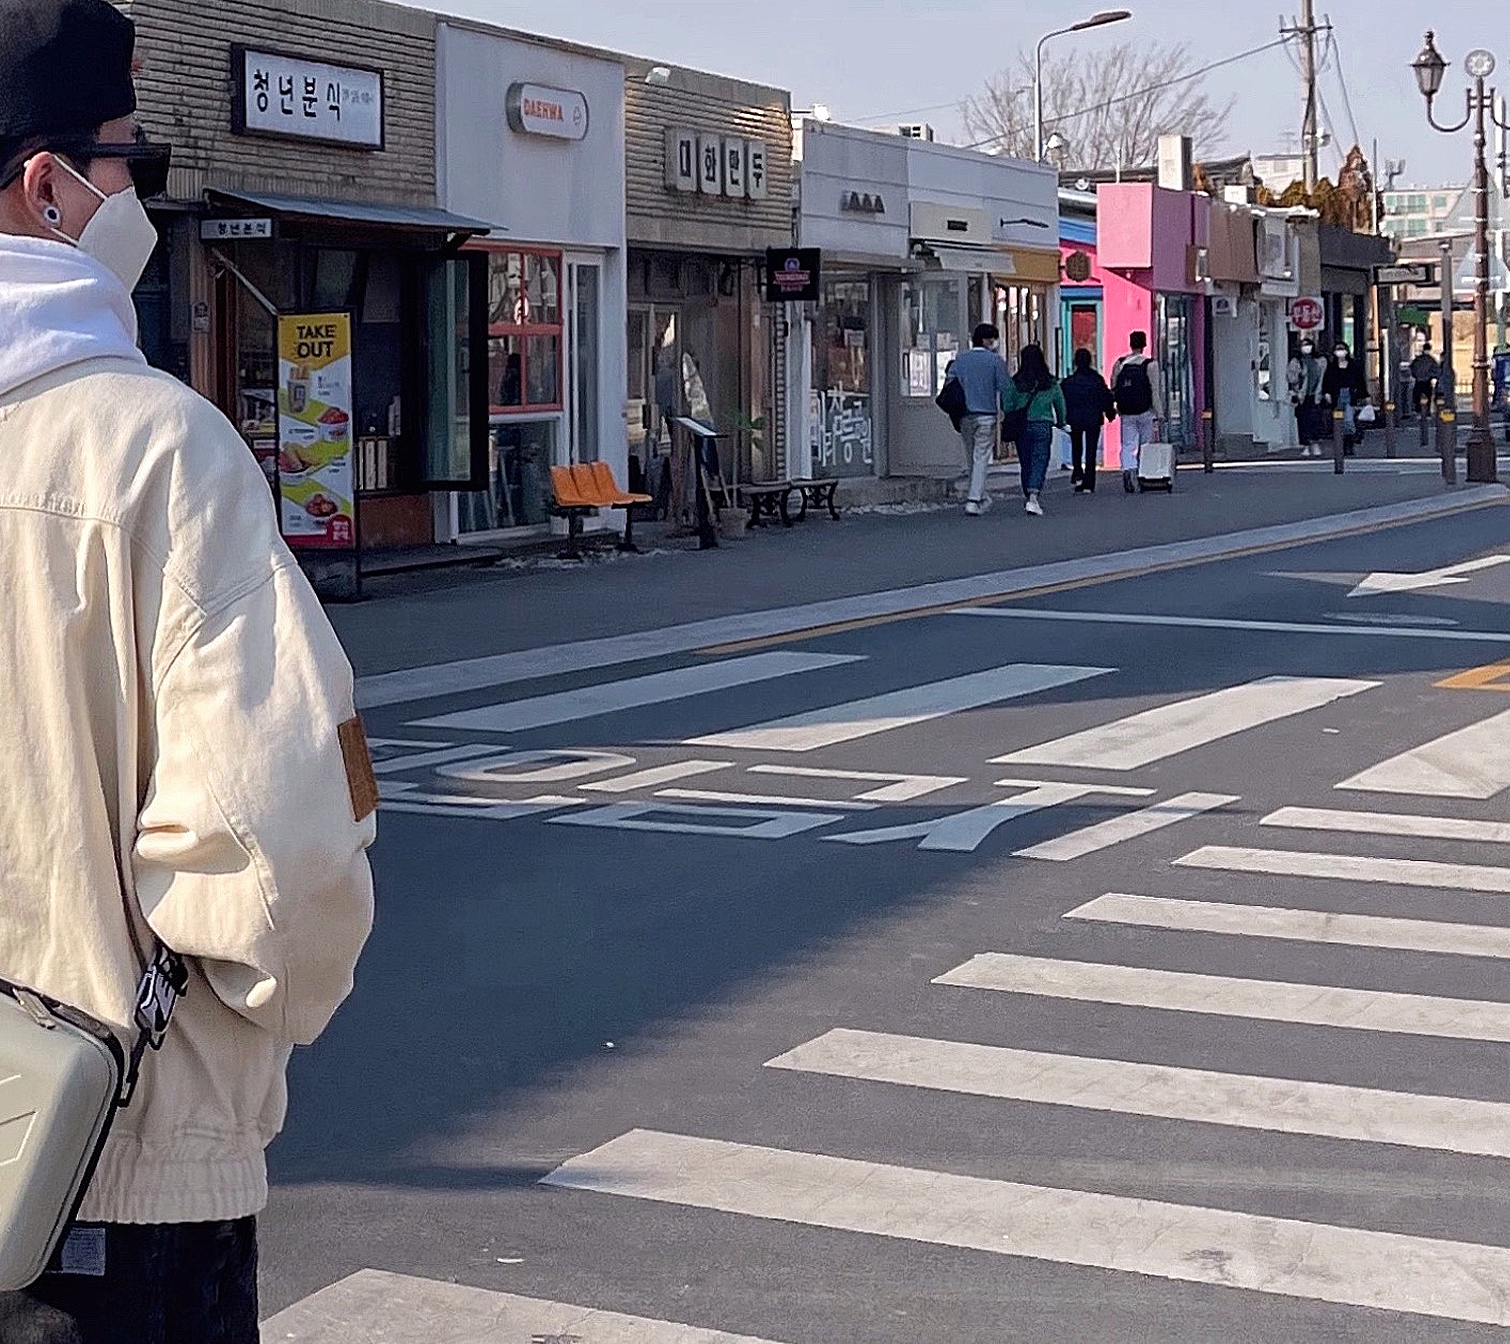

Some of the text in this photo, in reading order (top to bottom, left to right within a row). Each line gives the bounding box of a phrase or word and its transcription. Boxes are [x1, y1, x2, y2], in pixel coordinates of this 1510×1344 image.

[253, 68, 341, 122] 청년분식
[296, 325, 337, 339] TAKE
[297, 340, 334, 358] OUT
